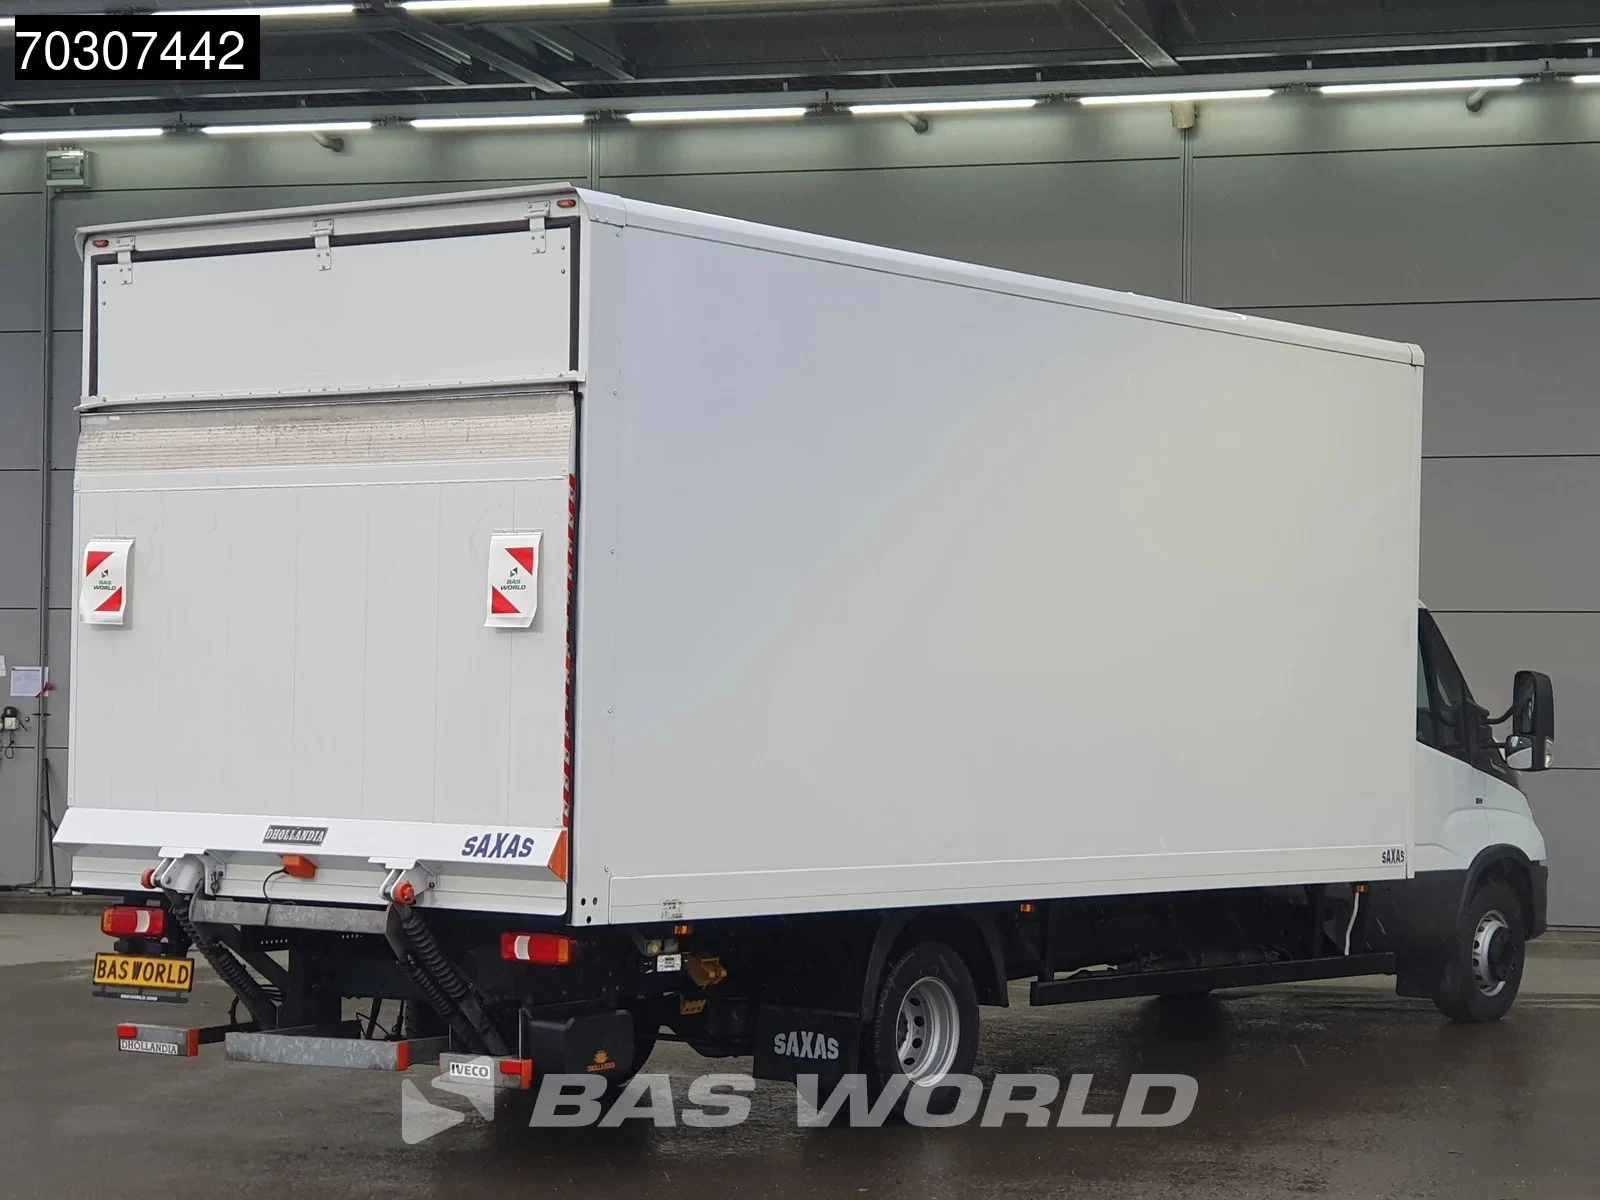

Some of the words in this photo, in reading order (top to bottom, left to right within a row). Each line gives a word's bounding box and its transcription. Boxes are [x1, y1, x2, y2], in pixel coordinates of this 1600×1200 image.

[264, 828, 325, 842] DHOLLANDIA
[461, 832, 535, 859] SAXAS
[1382, 848, 1405, 864] SAXAS
[97, 960, 129, 980] BAS
[132, 961, 188, 984] WORLD
[121, 1040, 177, 1054] DHOLLANDIA
[774, 1030, 839, 1060] SAXAS
[451, 1063, 490, 1077] IVECO
